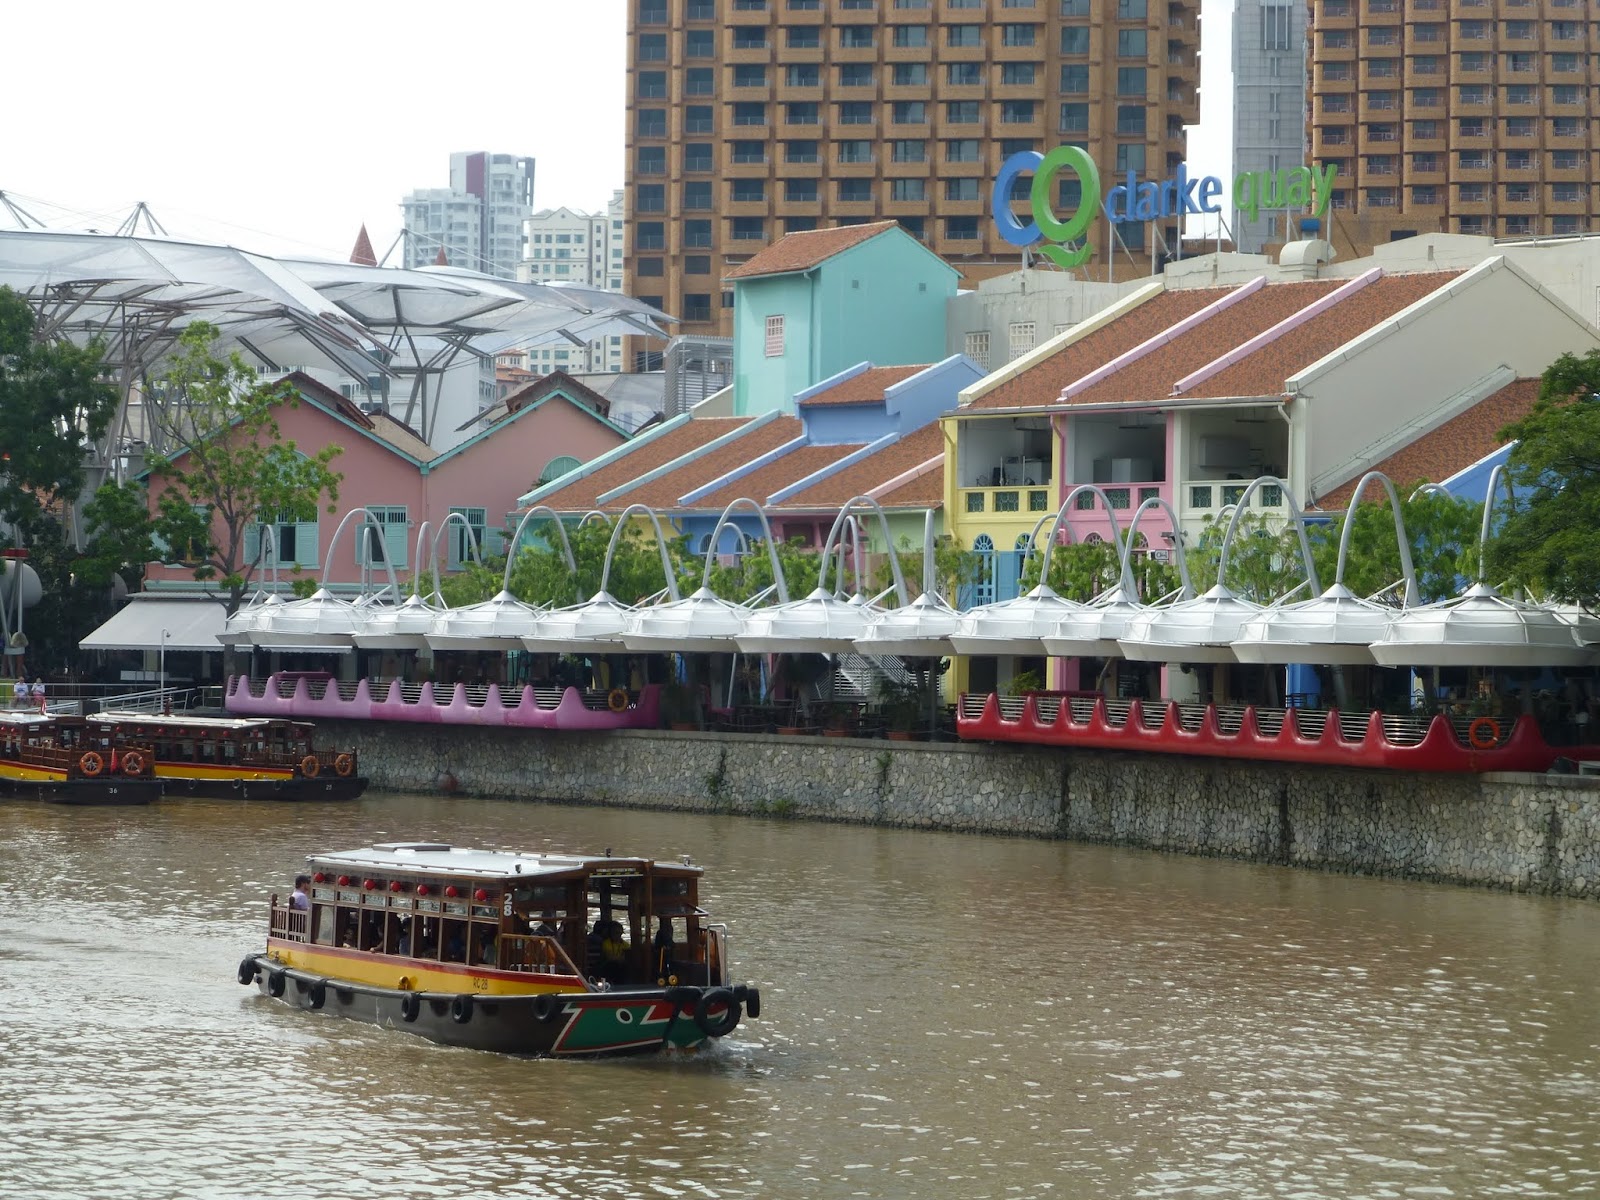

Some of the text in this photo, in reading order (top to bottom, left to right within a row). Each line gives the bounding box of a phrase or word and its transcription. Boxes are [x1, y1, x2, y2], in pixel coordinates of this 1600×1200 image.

[1106, 163, 1338, 224] clarke quay
[503, 892, 513, 917] 28
